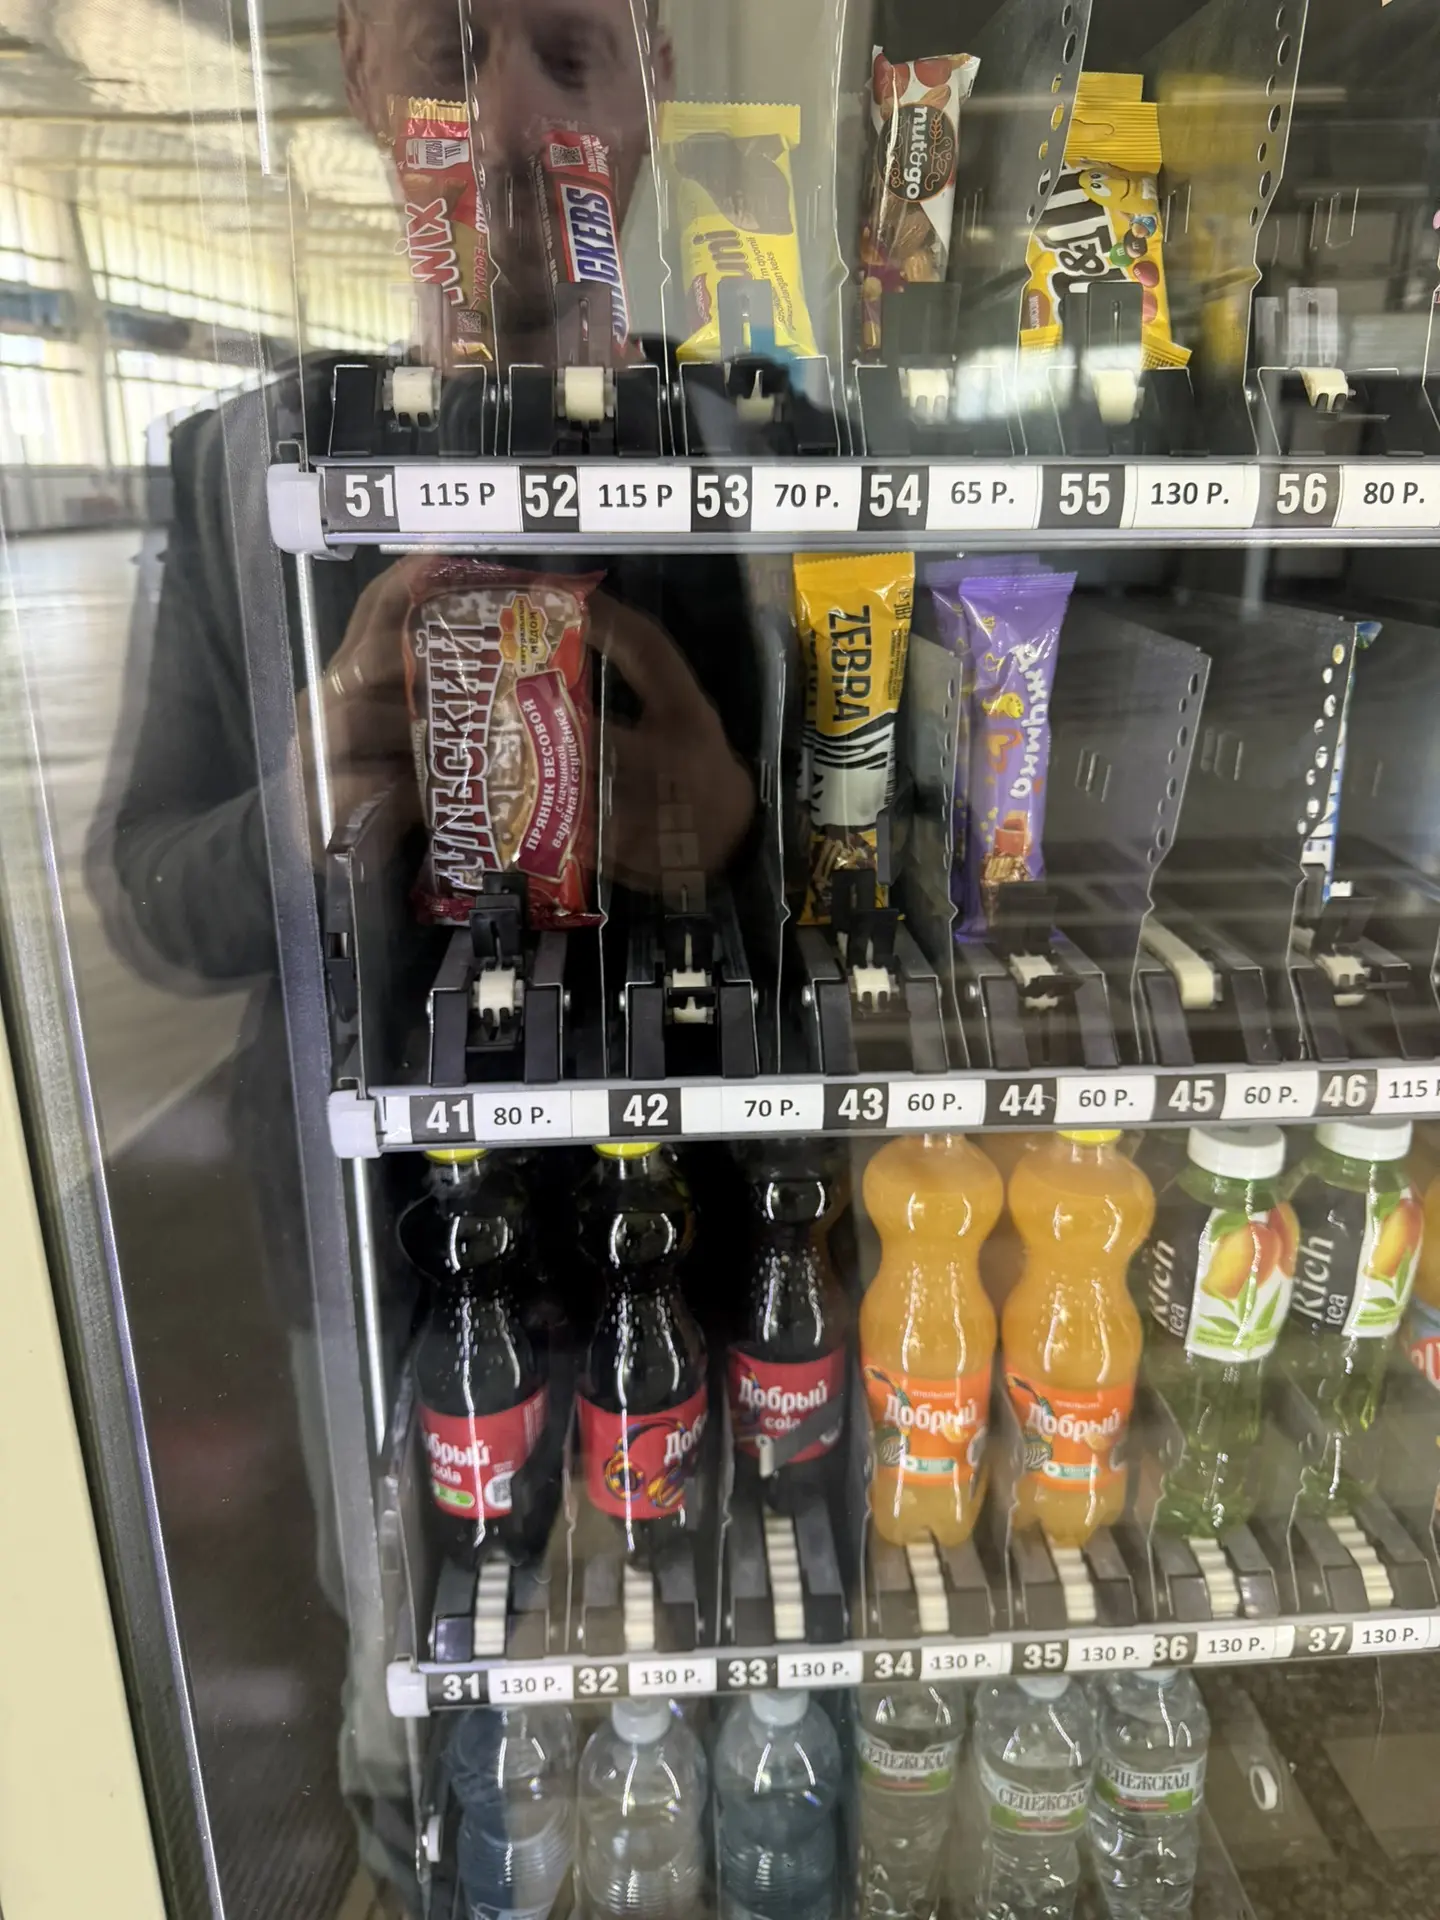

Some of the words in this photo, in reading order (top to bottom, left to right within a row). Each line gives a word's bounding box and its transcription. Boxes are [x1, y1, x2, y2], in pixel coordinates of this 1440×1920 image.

[903, 106, 928, 200] nut&go
[345, 474, 395, 518] 51
[419, 483, 470, 506] 115
[525, 474, 578, 518] 52
[599, 484, 648, 507] 115
[697, 474, 749, 518] 53
[774, 484, 807, 507] 70
[869, 474, 921, 517] 54
[950, 481, 982, 504] 65
[1059, 473, 1111, 516] 55
[1150, 482, 1199, 506] 130
[1276, 473, 1328, 515] 56
[1363, 482, 1395, 504] 80
[828, 605, 872, 723] ZEBRA
[522, 698, 556, 778] ВЕСОВОЙ
[553, 707, 581, 783] сгущёнка
[526, 782, 556, 852] ПРЯНИК
[551, 786, 580, 850] варёная
[838, 1087, 884, 1121] 43
[907, 1093, 935, 1111] 60
[999, 1084, 1045, 1117] 44
[1079, 1089, 1106, 1107] 60
[1168, 1079, 1215, 1112] 45
[1244, 1086, 1271, 1104] 60
[1322, 1074, 1368, 1107] 46
[1388, 1080, 1428, 1099] 115
[426, 1099, 470, 1134] 41
[493, 1107, 522, 1125] 80
[623, 1093, 669, 1127] 42
[744, 1099, 772, 1117] 70
[1292, 1235, 1336, 1321] Rich
[1168, 1302, 1188, 1338] tea
[1325, 1293, 1348, 1327] tea
[739, 1375, 828, 1415] Добрый
[884, 1393, 977, 1436] Добрый
[1026, 1402, 1121, 1444] Добрый
[1152, 1636, 1189, 1662] 36
[1207, 1638, 1243, 1654] 130
[1308, 1626, 1346, 1653] 37
[1362, 1628, 1397, 1645] 130
[874, 1650, 914, 1679] 34
[931, 1654, 968, 1671] 130
[1022, 1643, 1064, 1671] 35
[1081, 1646, 1117, 1662] 130
[578, 1666, 620, 1695] 32
[641, 1669, 677, 1686] 130
[728, 1658, 768, 1688] 33
[789, 1662, 825, 1678] 130
[442, 1672, 481, 1701] 31
[500, 1678, 537, 1695] 130
